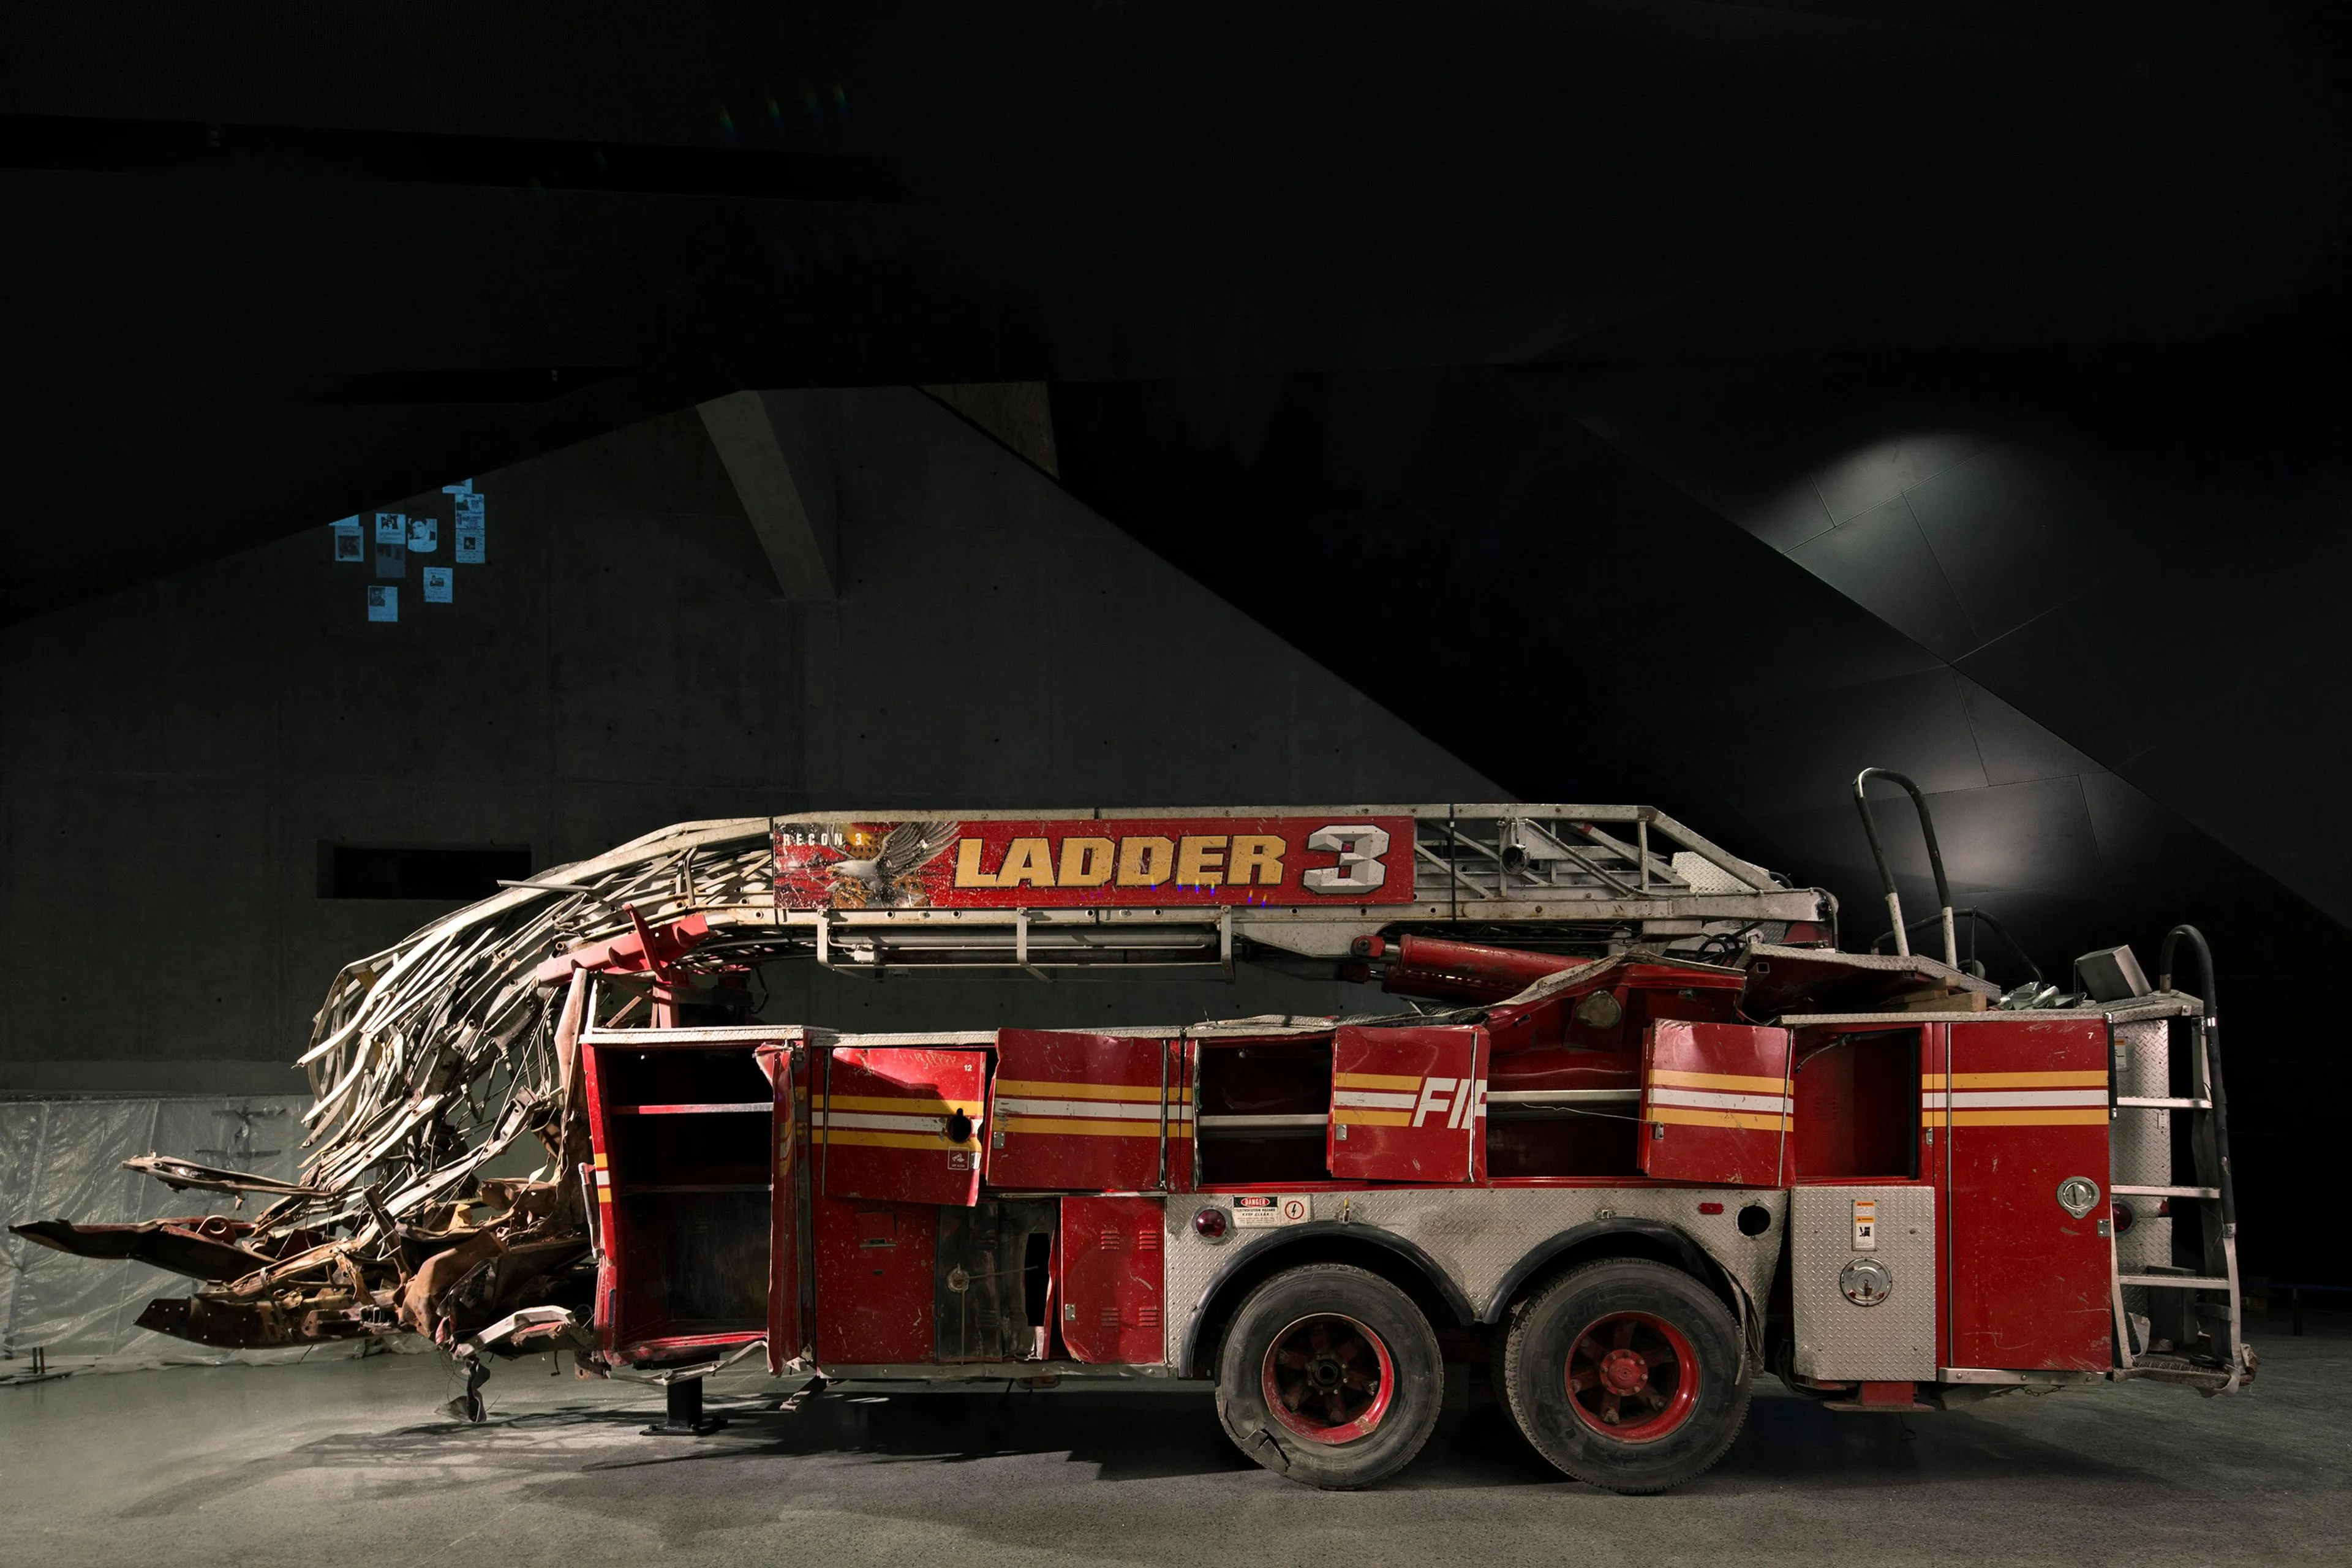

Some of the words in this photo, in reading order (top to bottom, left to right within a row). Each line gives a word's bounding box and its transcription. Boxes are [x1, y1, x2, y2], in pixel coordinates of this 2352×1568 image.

[783, 833, 843, 846] RECON
[855, 833, 862, 845] 3
[954, 835, 1286, 888] LADDER
[1302, 824, 1392, 895] 3
